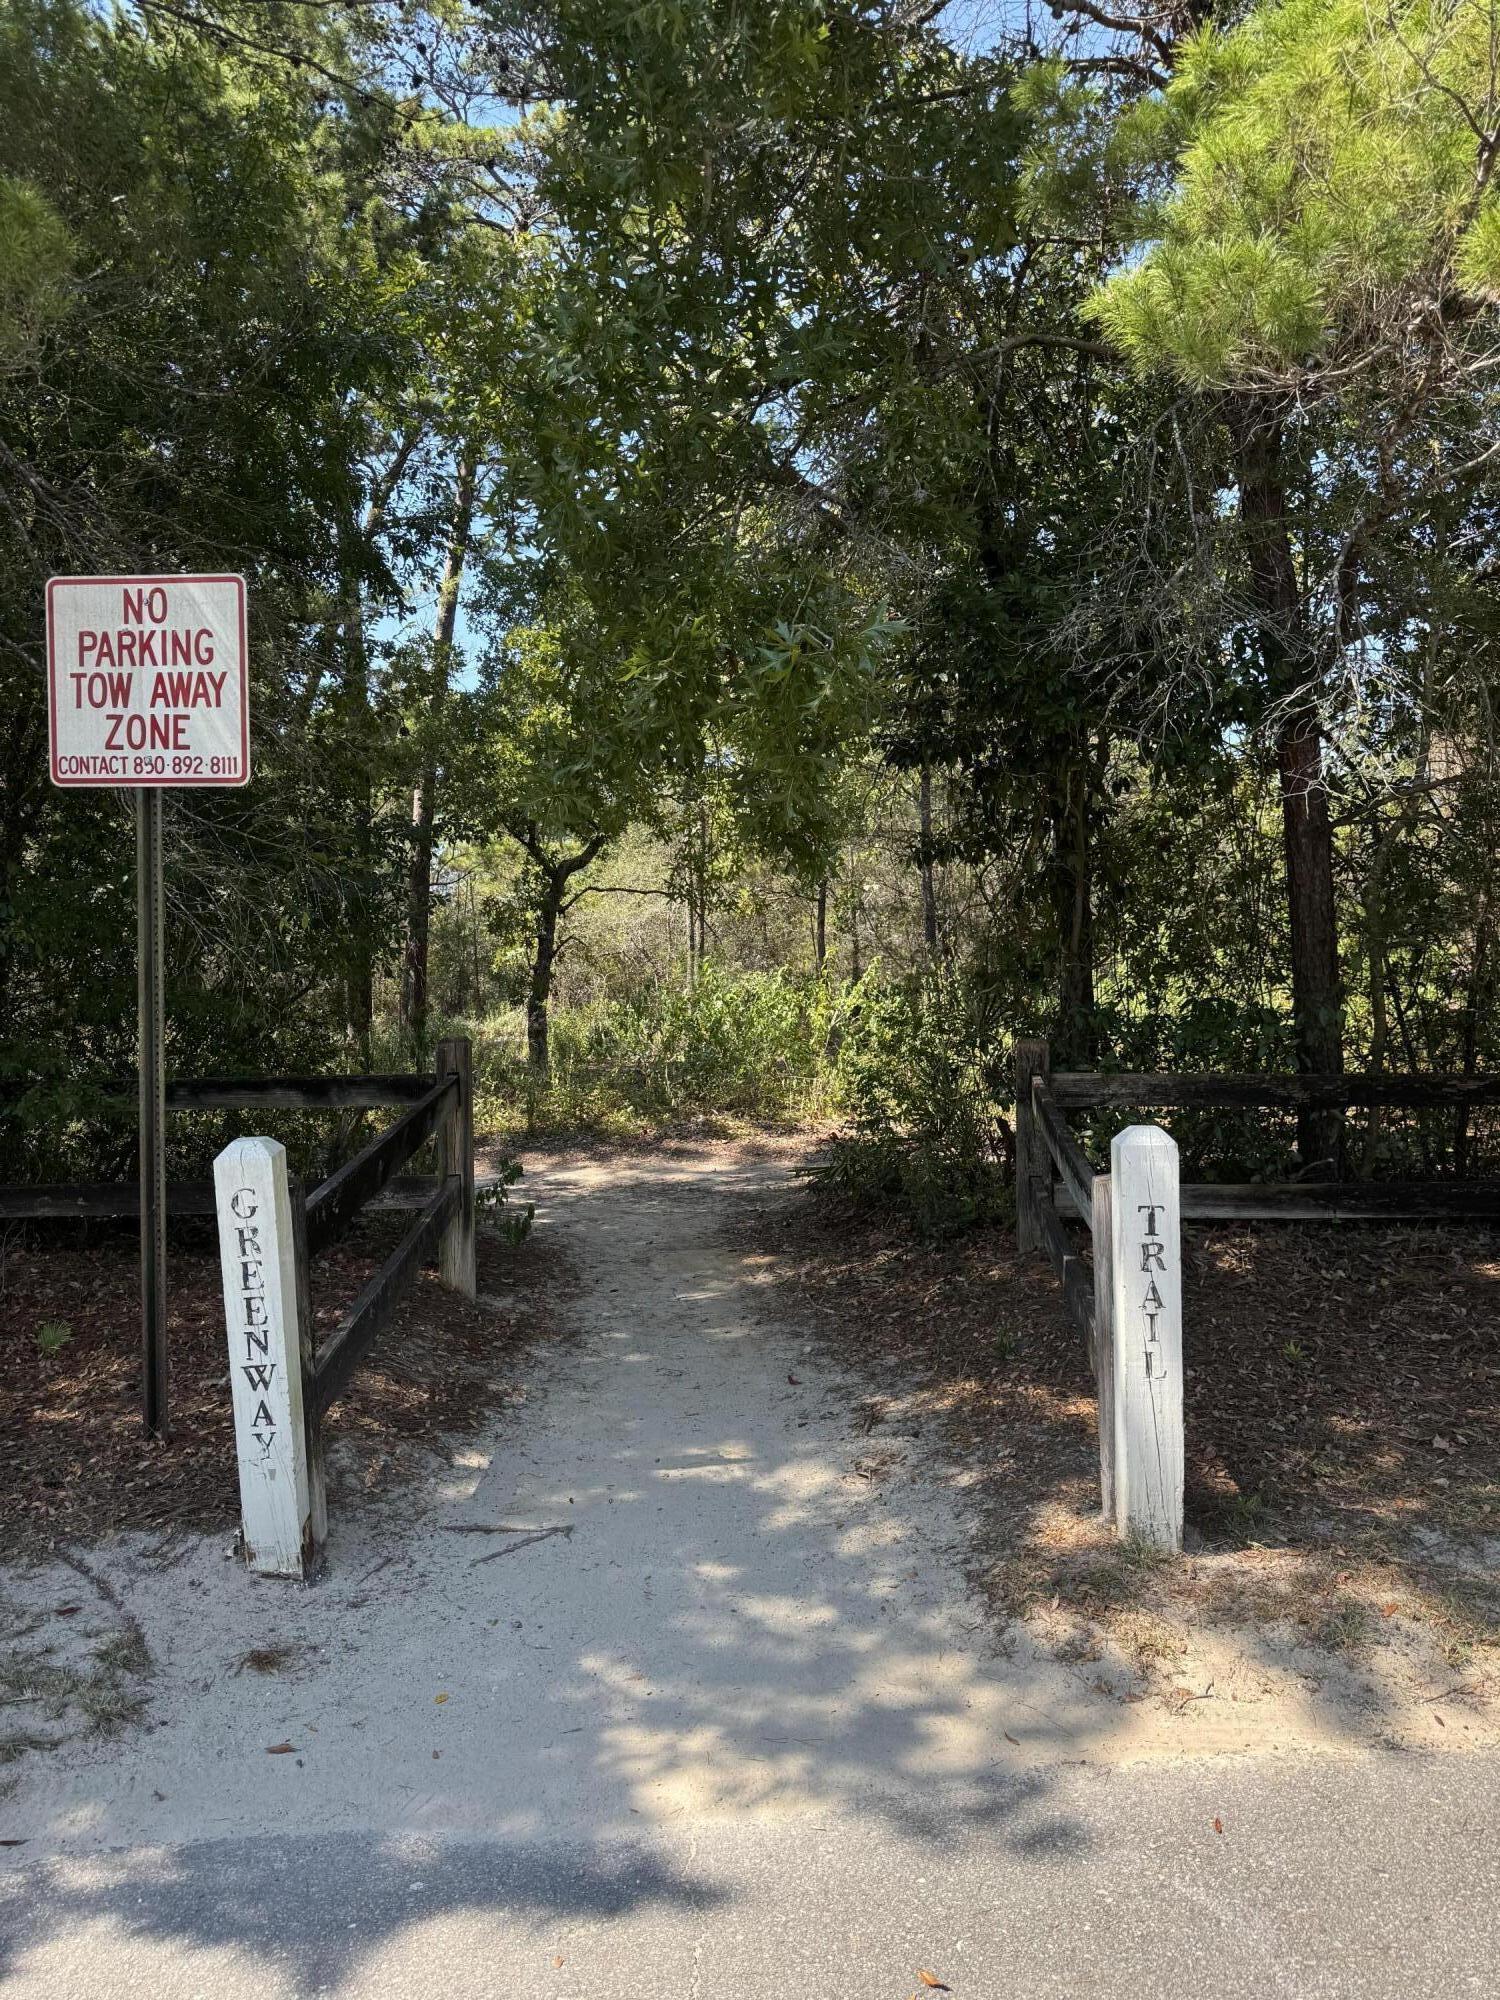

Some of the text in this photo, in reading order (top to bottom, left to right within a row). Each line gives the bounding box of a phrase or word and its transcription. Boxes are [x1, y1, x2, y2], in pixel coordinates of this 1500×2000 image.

[123, 587, 168, 625] NO
[78, 628, 214, 667] PARKING
[70, 671, 228, 709] TOW AWAY
[105, 714, 191, 750] ZONE
[58, 756, 129, 775] CONTACT
[1137, 1204, 1168, 1381] TRAIL
[231, 1187, 277, 1461] GREENWAY
